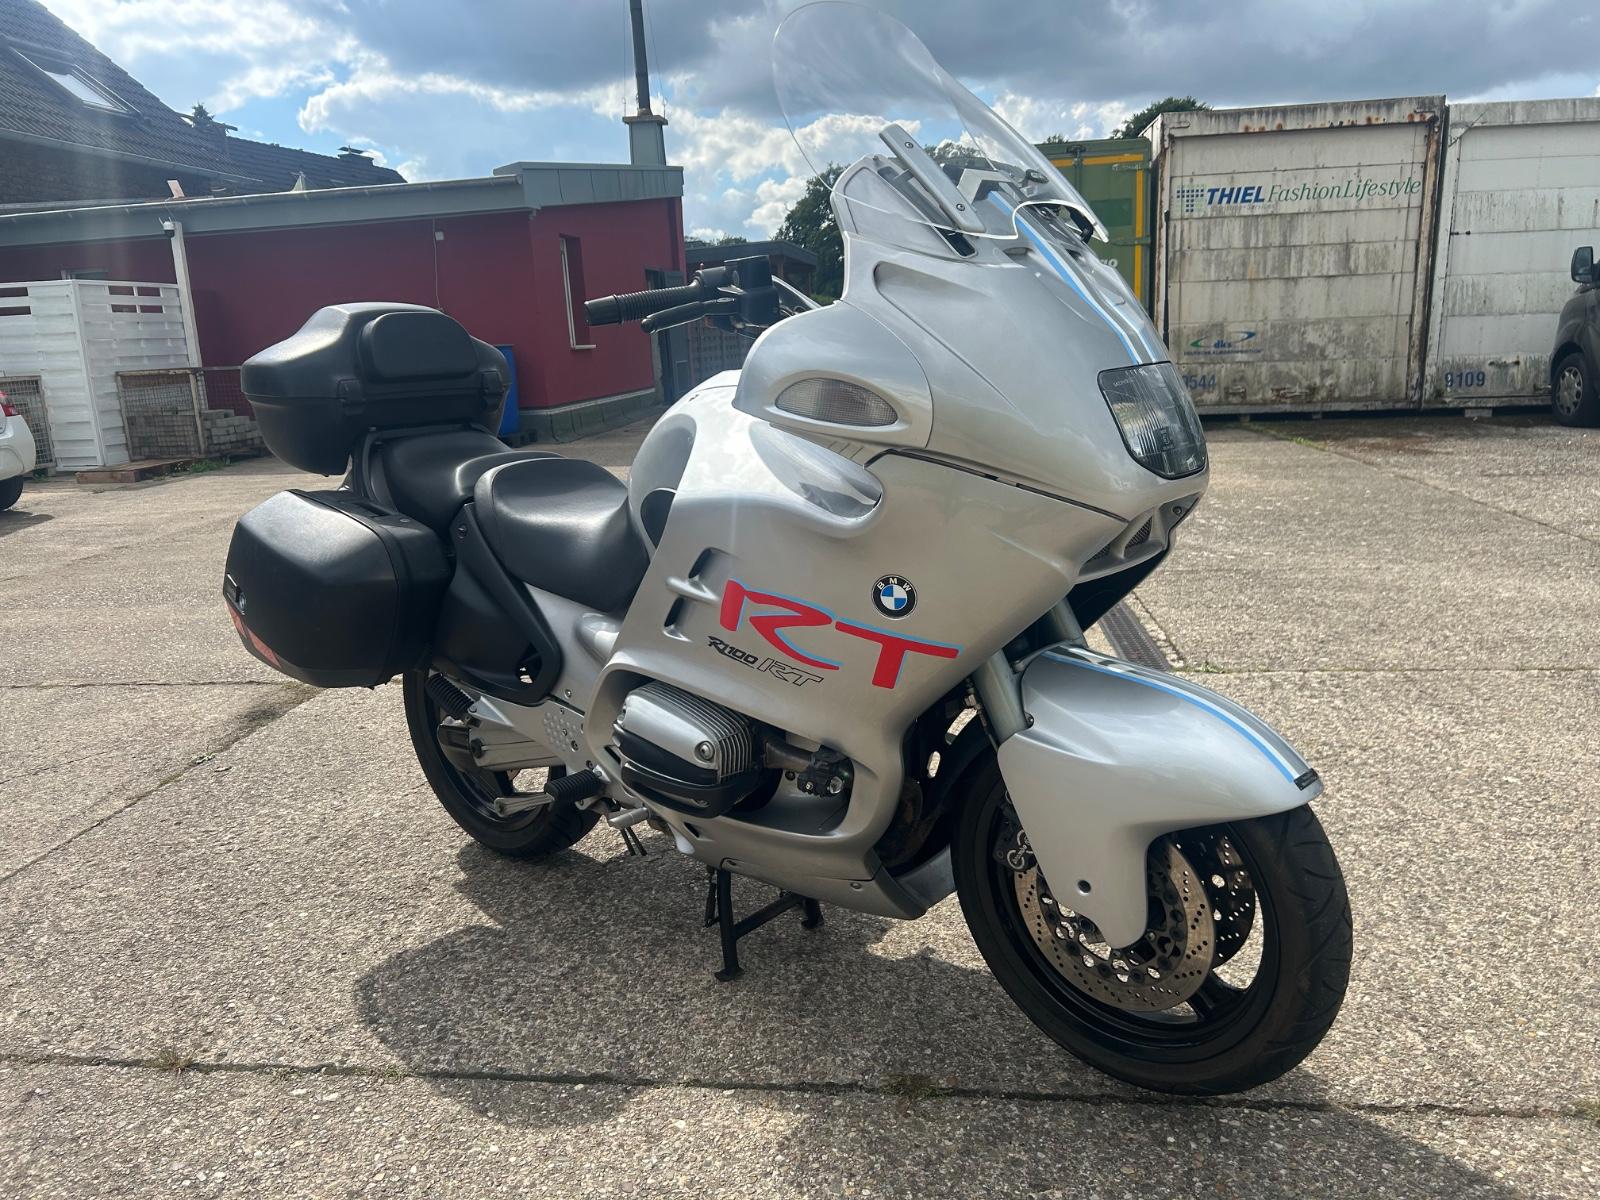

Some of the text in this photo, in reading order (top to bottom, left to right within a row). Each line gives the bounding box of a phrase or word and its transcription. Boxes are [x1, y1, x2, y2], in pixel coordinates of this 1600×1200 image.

[1207, 186, 1265, 206] THIEL
[1444, 371, 1486, 388] 9109
[876, 577, 912, 592] BMW
[720, 577, 964, 689] RT
[757, 658, 825, 687] RT
